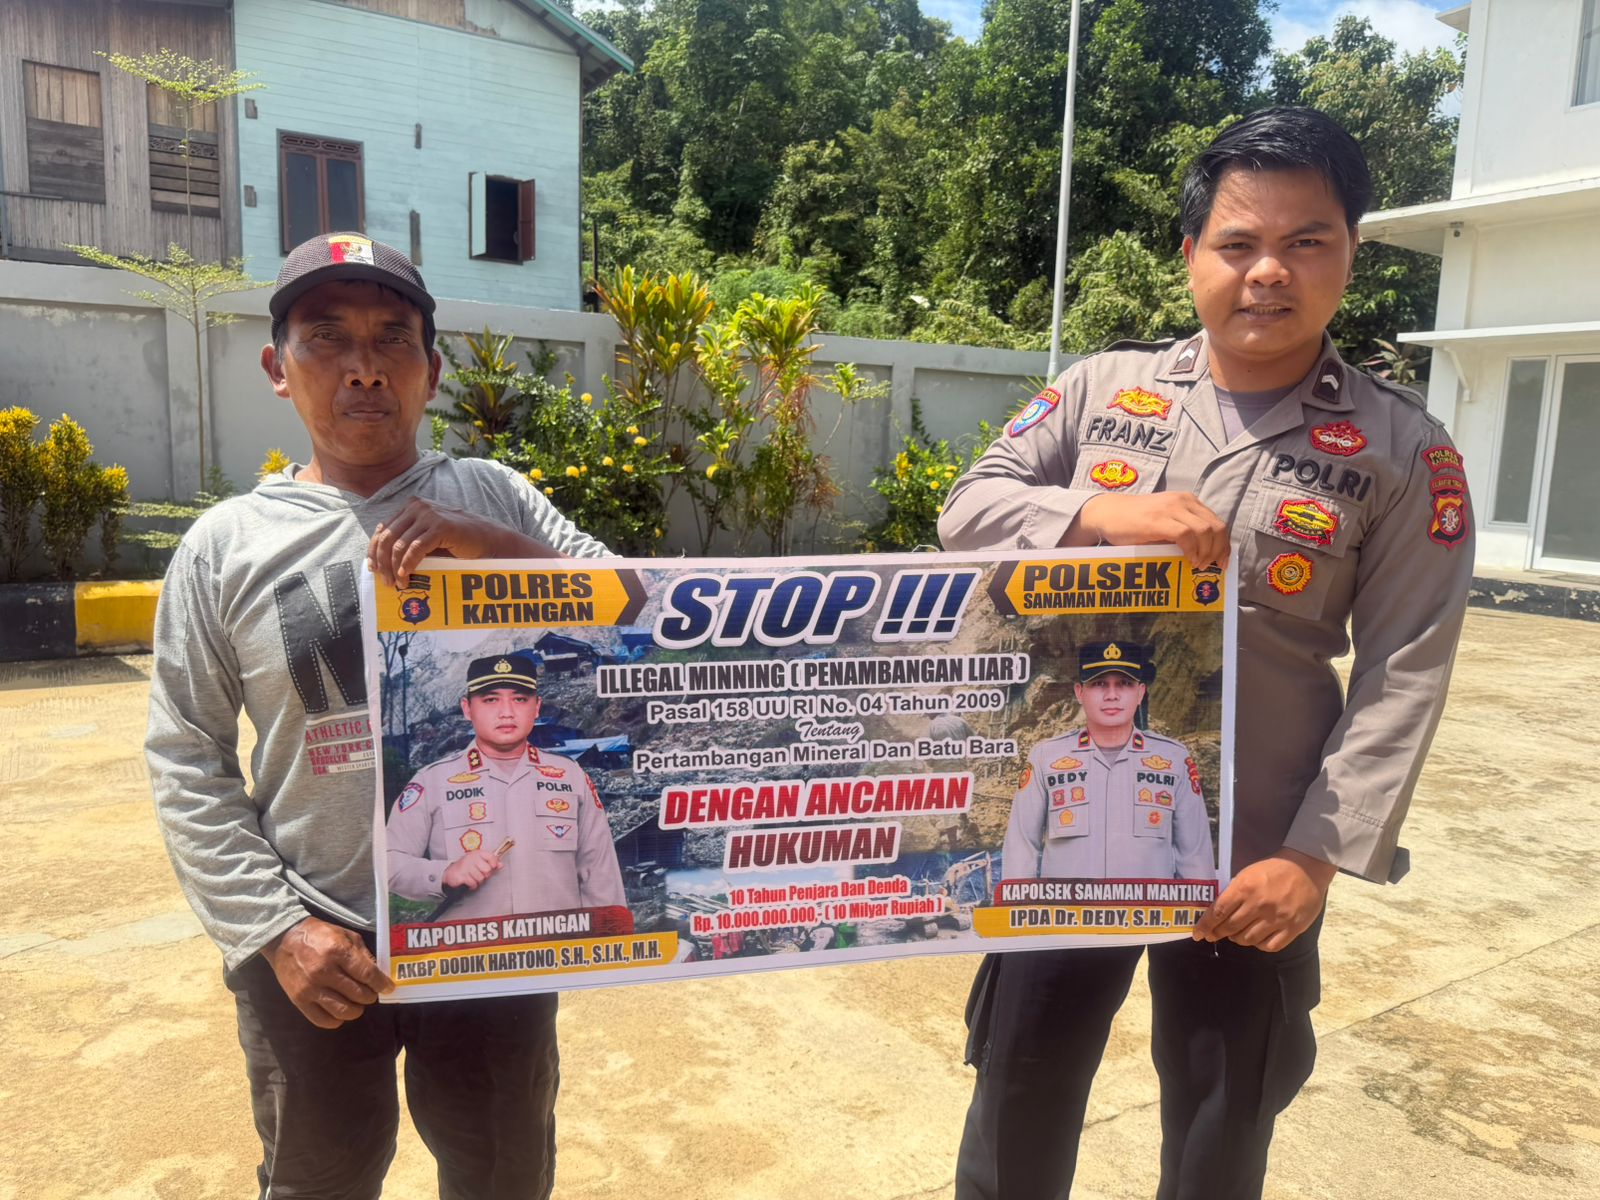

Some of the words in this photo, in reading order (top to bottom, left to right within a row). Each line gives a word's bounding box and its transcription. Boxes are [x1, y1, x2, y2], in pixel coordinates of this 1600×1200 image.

[1086, 416, 1174, 452] FRANZ
[1272, 453, 1371, 501] POLRI
[461, 573, 593, 600] POLRES
[1023, 561, 1172, 592] POLSEK
[462, 602, 593, 624] KATINGAN
[660, 574, 876, 643] STOP
[1023, 592, 1096, 609] SANAMAN
[1100, 590, 1170, 608] MANTIKEI
[600, 667, 684, 695] ILLEGAL
[688, 663, 785, 691] MINNING
[804, 657, 963, 687] PENAMBANGAN
[968, 656, 1014, 681] LIAR
[650, 703, 708, 722] Pasal
[714, 701, 750, 719] 158
[756, 699, 786, 716] UU
[793, 698, 813, 715] RI
[820, 697, 853, 714] No.
[860, 698, 883, 713] 04
[889, 694, 950, 712] Tahun
[955, 692, 1001, 710] 2009
[305, 720, 363, 744] ATHLETIC
[799, 721, 861, 740] Tentang
[636, 750, 787, 770] Pertambangan
[793, 743, 866, 763] Mineral
[873, 745, 912, 760] Dan
[918, 740, 963, 757] Batu
[969, 739, 1015, 755] Bara
[446, 786, 484, 801] DODIK
[536, 781, 573, 793] POLRI
[1048, 771, 1087, 787] DEDY
[1136, 772, 1174, 786] POLRI
[664, 784, 799, 825] DENGAN
[804, 776, 969, 817] ANCAMAN
[728, 826, 896, 869] HUKUMAN
[729, 889, 745, 906] 10
[746, 887, 787, 904] Tahun
[789, 883, 838, 901] Penjara
[841, 881, 865, 897] Dan
[868, 878, 907, 895] Denda
[1002, 884, 1073, 901] KAPOLSEK
[1075, 884, 1143, 901] SANAMAN
[1147, 884, 1215, 902] MANTIKEI
[693, 915, 714, 932] Rp.
[716, 906, 823, 930] 10.000.000.000,-
[832, 903, 847, 920] 10
[849, 902, 889, 919] Milyar
[891, 899, 934, 915] Rupiah
[1011, 911, 1051, 926] IPDA
[1055, 911, 1078, 926] Dr.
[1082, 910, 1129, 928] DEDY,
[1133, 910, 1170, 927] S.H.,
[407, 922, 499, 948] KAPOLRES
[502, 913, 590, 939] KATINGAN
[397, 961, 436, 980] AKBP
[440, 955, 486, 975] DODIK
[488, 947, 558, 972] HARTONO,
[561, 946, 590, 967] S.H.,
[633, 940, 661, 960] M.H.
